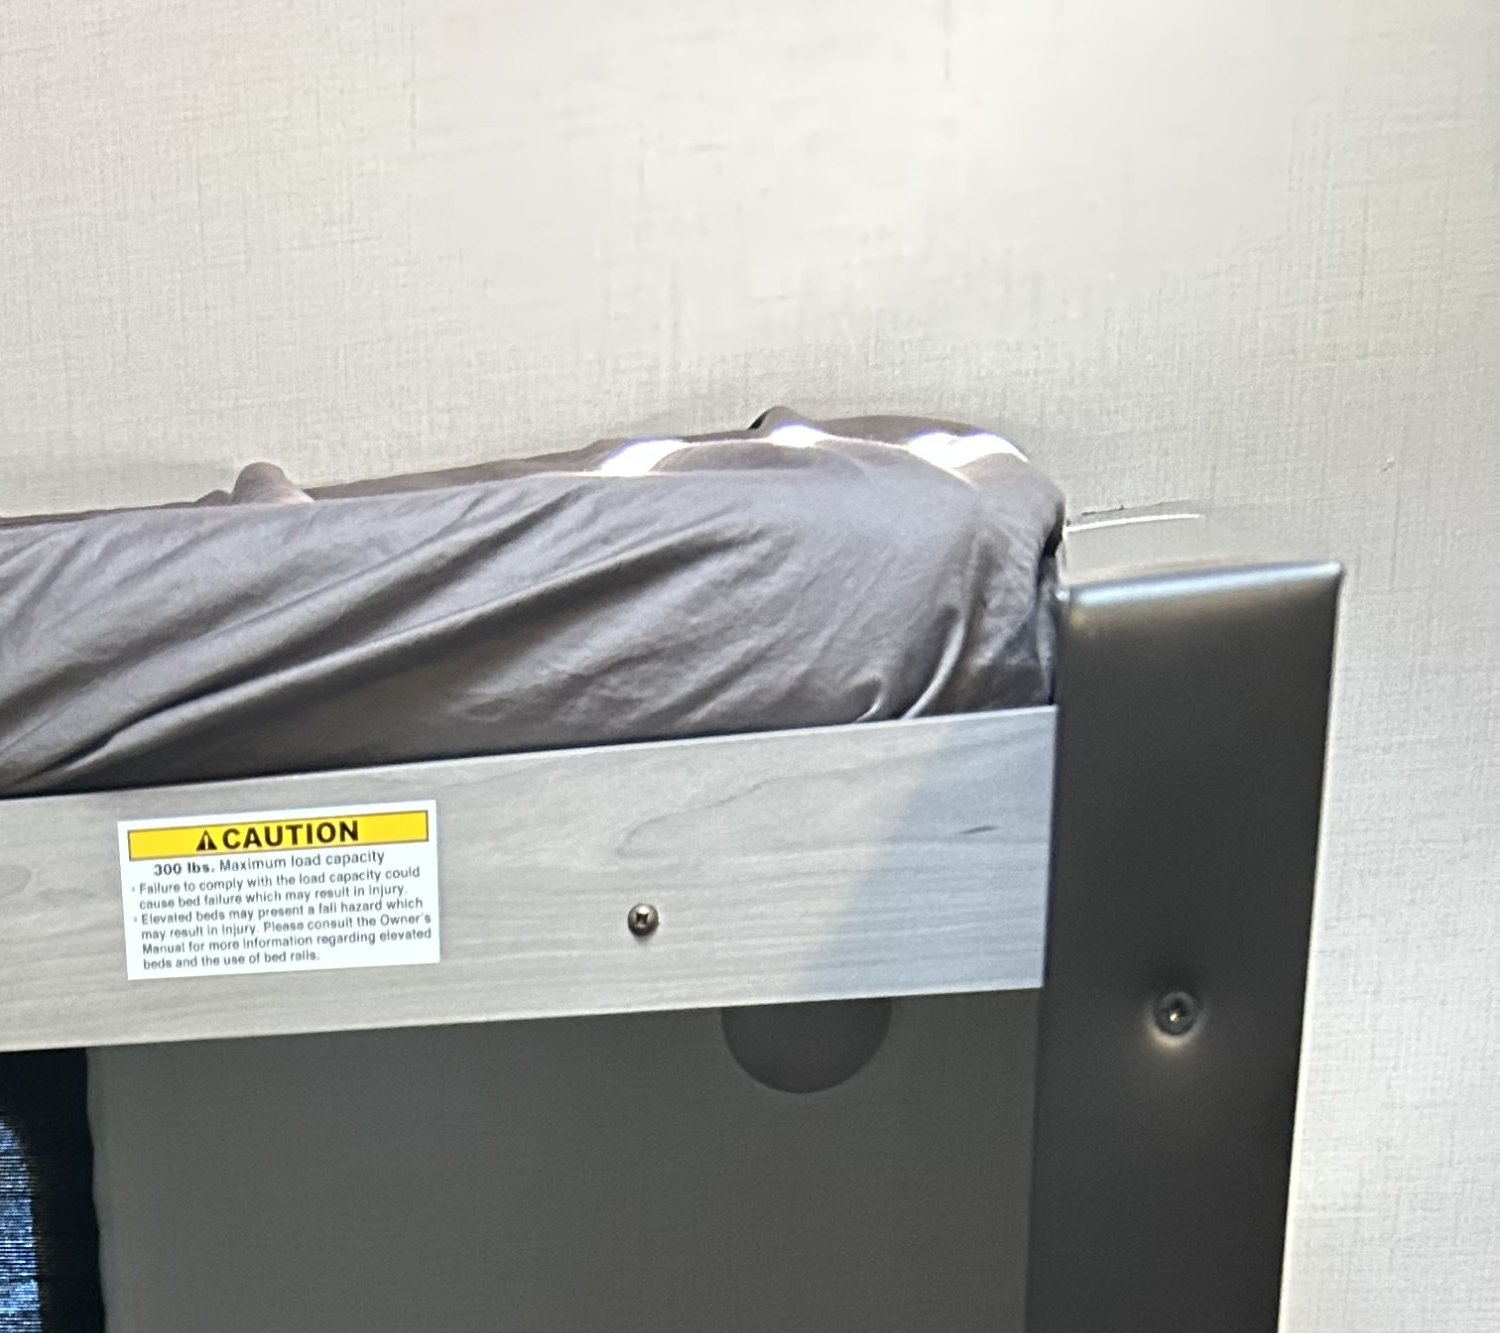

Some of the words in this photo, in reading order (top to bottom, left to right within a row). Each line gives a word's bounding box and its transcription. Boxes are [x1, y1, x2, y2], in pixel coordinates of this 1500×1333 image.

[222, 820, 359, 850] CAUTION
[153, 863, 182, 876] 300
[187, 861, 215, 874] lbs.
[220, 857, 287, 872] Maximum
[291, 854, 321, 868] load
[325, 849, 385, 868] capacity
[139, 881, 180, 895] Failure
[183, 881, 196, 892] to
[199, 876, 243, 892] comply
[247, 874, 272, 888] with
[276, 873, 296, 886] the
[299, 871, 326, 885] load
[329, 868, 381, 884] capacity
[385, 865, 420, 879] could
[139, 899, 175, 910] cause
[178, 895, 201, 908] bed
[204, 893, 243, 906] failure
[245, 890, 282, 903] which
[285, 890, 311, 903] may
[315, 885, 349, 899] result
[353, 885, 365, 897] in
[141, 910, 192, 925] Elevated
[196, 908, 225, 922] beds
[229, 909, 254, 921] may
[258, 904, 304, 920] present
[308, 905, 315, 916] a
[318, 901, 337, 914] fall
[340, 899, 382, 913] hazard
[386, 897, 423, 910] which
[141, 929, 166, 942] may
[170, 925, 203, 938] result
[207, 924, 218, 936] in
[263, 919, 304, 933] Please
[307, 916, 353, 930] consult
[357, 915, 377, 927] the
[142, 941, 185, 955] Manual
[188, 940, 205, 952] for
[209, 940, 240, 951] more
[242, 935, 313, 949] information
[316, 931, 376, 947] regarding
[379, 927, 432, 942] elevated
[143, 957, 172, 970] beds
[176, 955, 198, 968] and
[201, 954, 220, 967] the
[223, 955, 245, 966] use
[248, 951, 260, 964] of
[264, 951, 287, 963] bed
